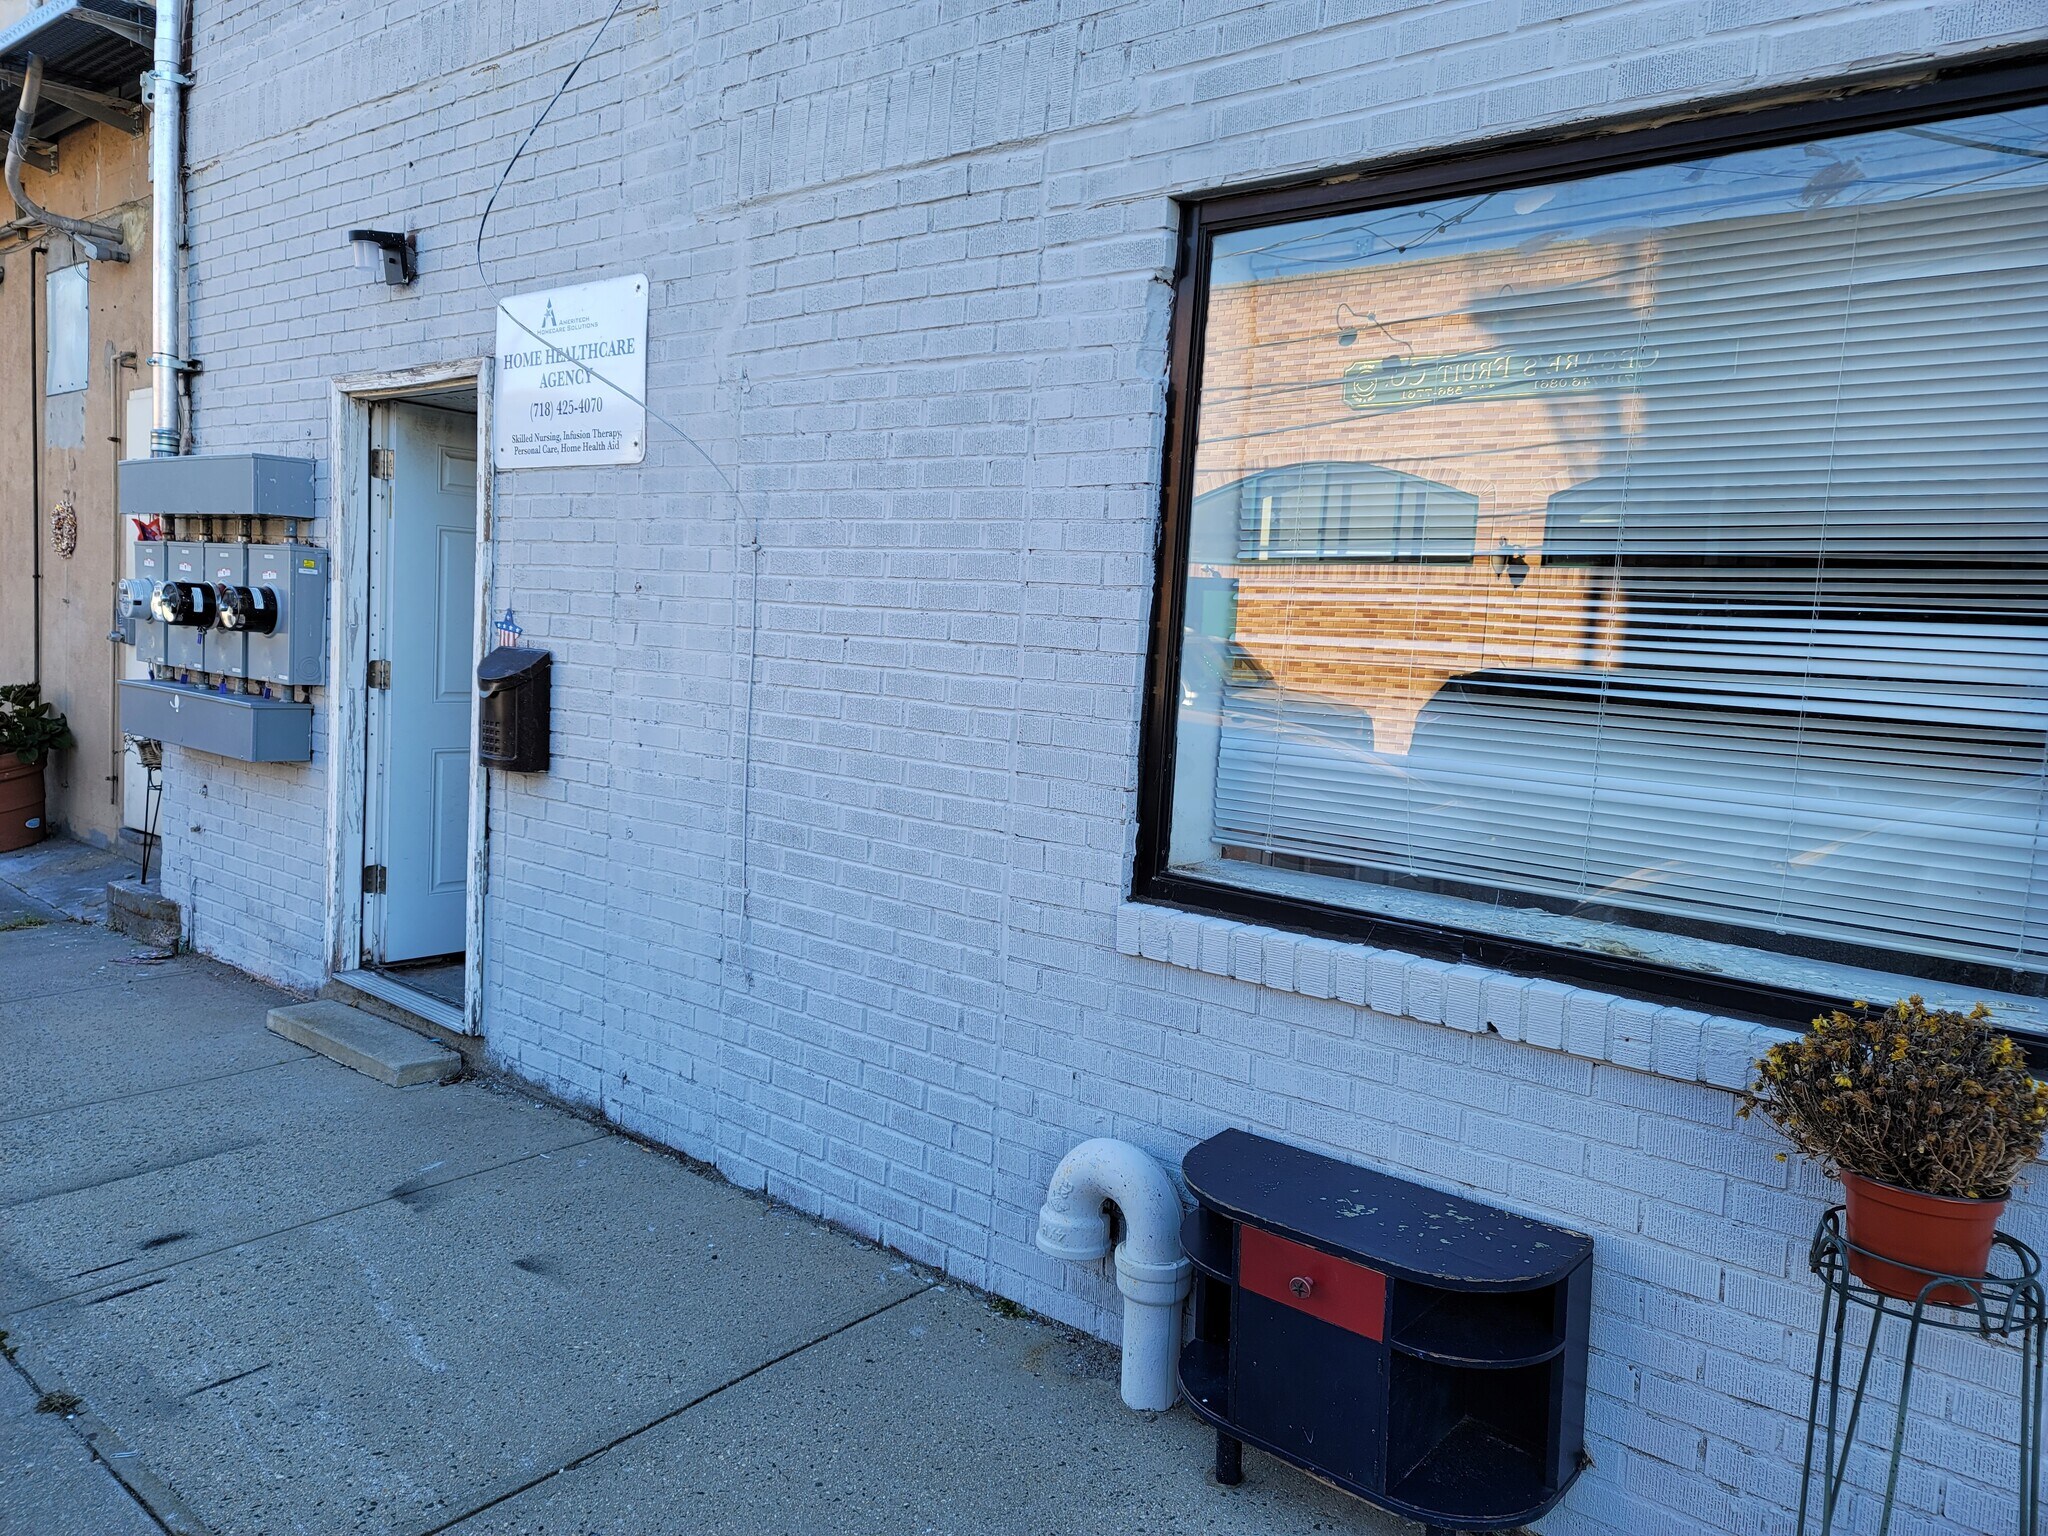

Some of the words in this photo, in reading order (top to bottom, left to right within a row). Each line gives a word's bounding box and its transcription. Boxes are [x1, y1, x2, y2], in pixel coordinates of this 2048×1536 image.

[536, 326, 566, 336] HOMECARE
[567, 321, 599, 332] SOLUTIONS
[558, 316, 590, 326] AMERITECH
[503, 350, 542, 370] HOME
[545, 338, 635, 365] HEALTHCARE
[539, 367, 594, 389] AGENCY
[529, 401, 554, 422] (718)
[556, 397, 603, 416] 425-4070
[511, 433, 533, 444] Skilled
[534, 432, 562, 444] Nursing,
[563, 430, 592, 440] Infusion
[592, 428, 623, 440] Therapy,
[514, 445, 541, 456] Personal
[542, 445, 560, 455] Care,
[560, 443, 581, 453] Home
[582, 441, 606, 452] Health
[606, 440, 620, 451] Aid
